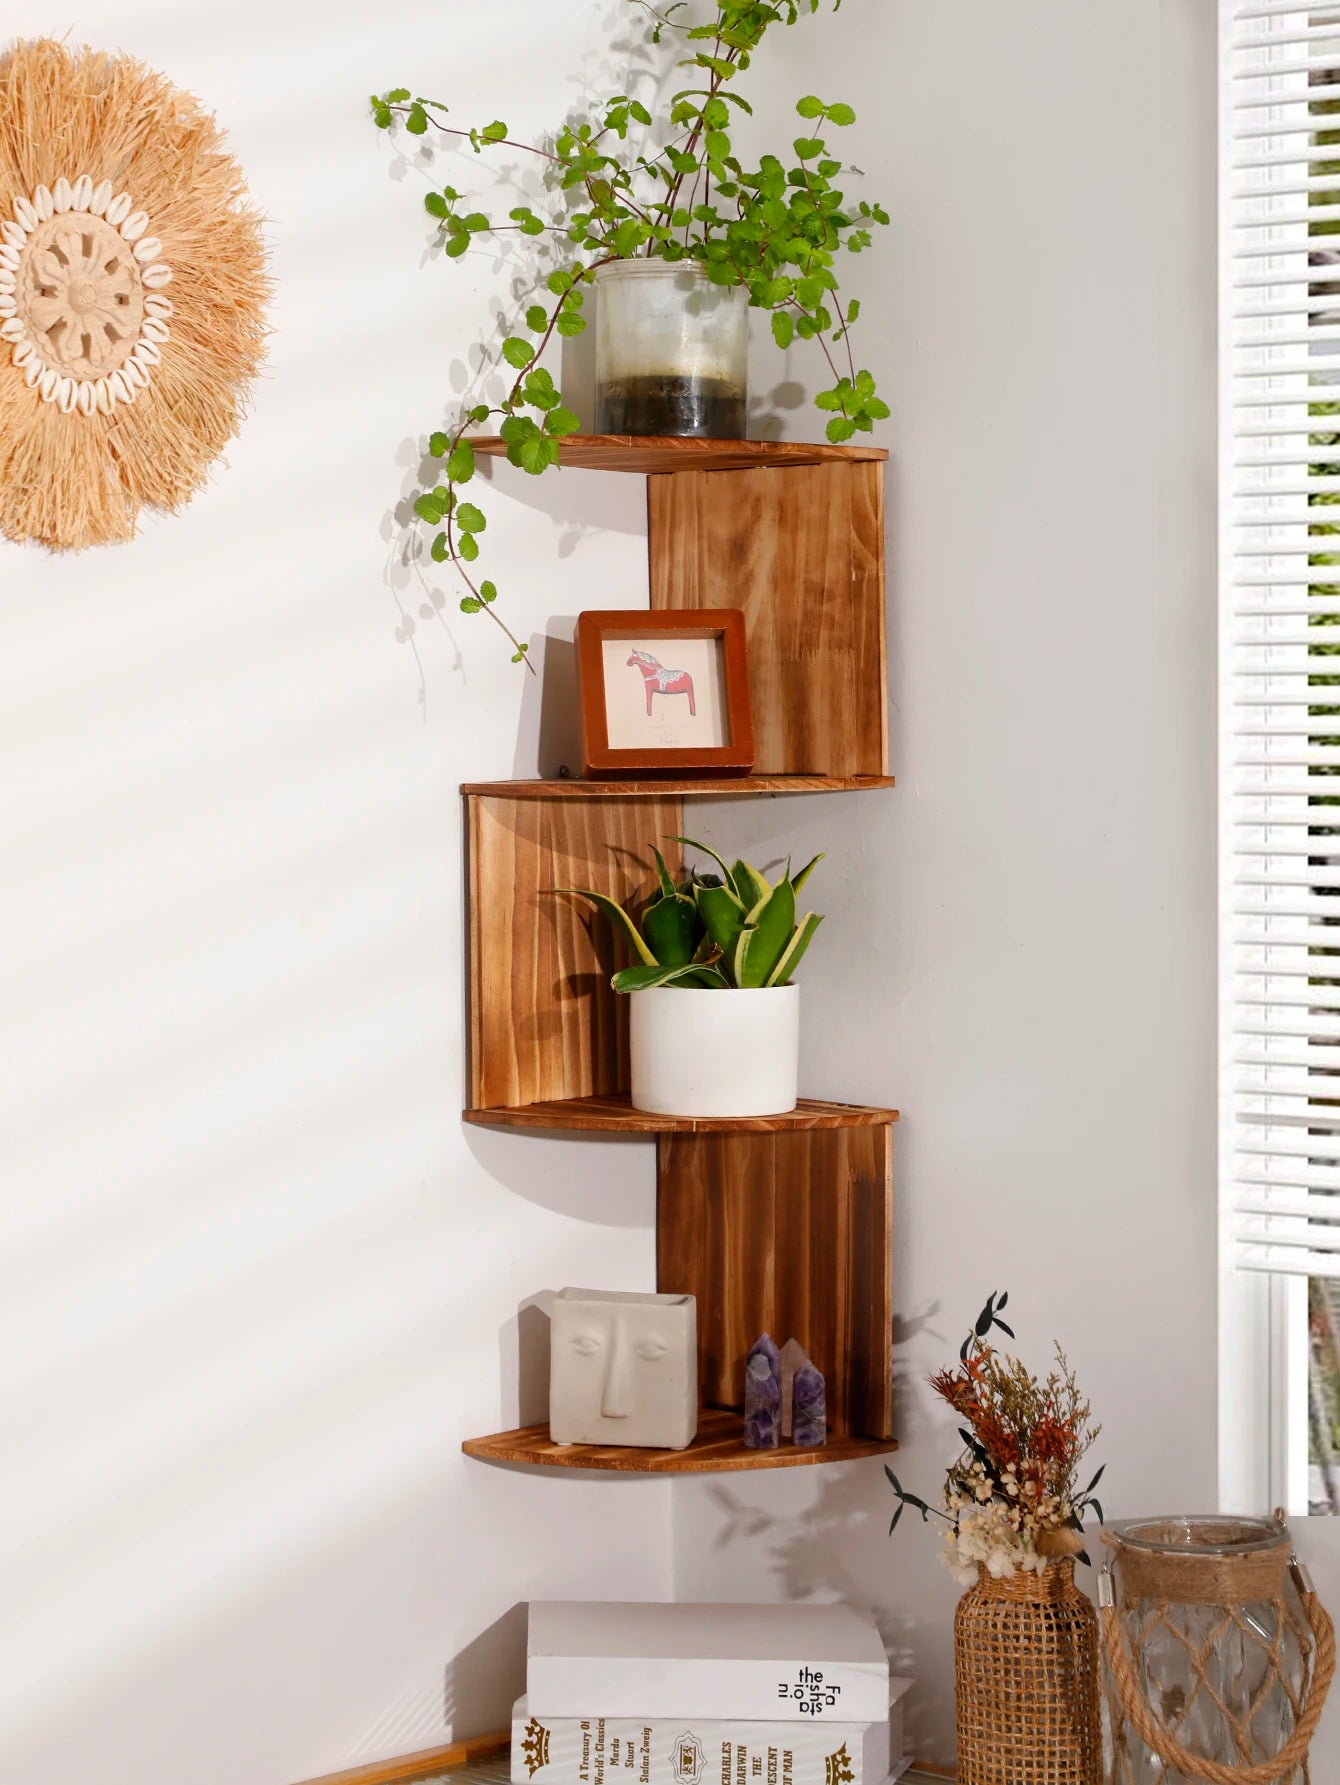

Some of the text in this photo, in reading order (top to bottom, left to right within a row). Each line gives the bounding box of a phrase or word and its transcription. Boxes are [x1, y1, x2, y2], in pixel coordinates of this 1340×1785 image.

[799, 1666, 823, 1683] the
[581, 1721, 590, 1730] Of
[580, 1732, 592, 1771] Treasury
[595, 1718, 605, 1785] World's Classics
[610, 1738, 620, 1766] Marda
[641, 1727, 652, 1753] Zweig
[625, 1741, 634, 1768] Stuart
[722, 1741, 732, 1785] CHARLES
[737, 1745, 747, 1785] DARWIN
[752, 1756, 762, 1776] THE
[783, 1750, 793, 1773] MAN
